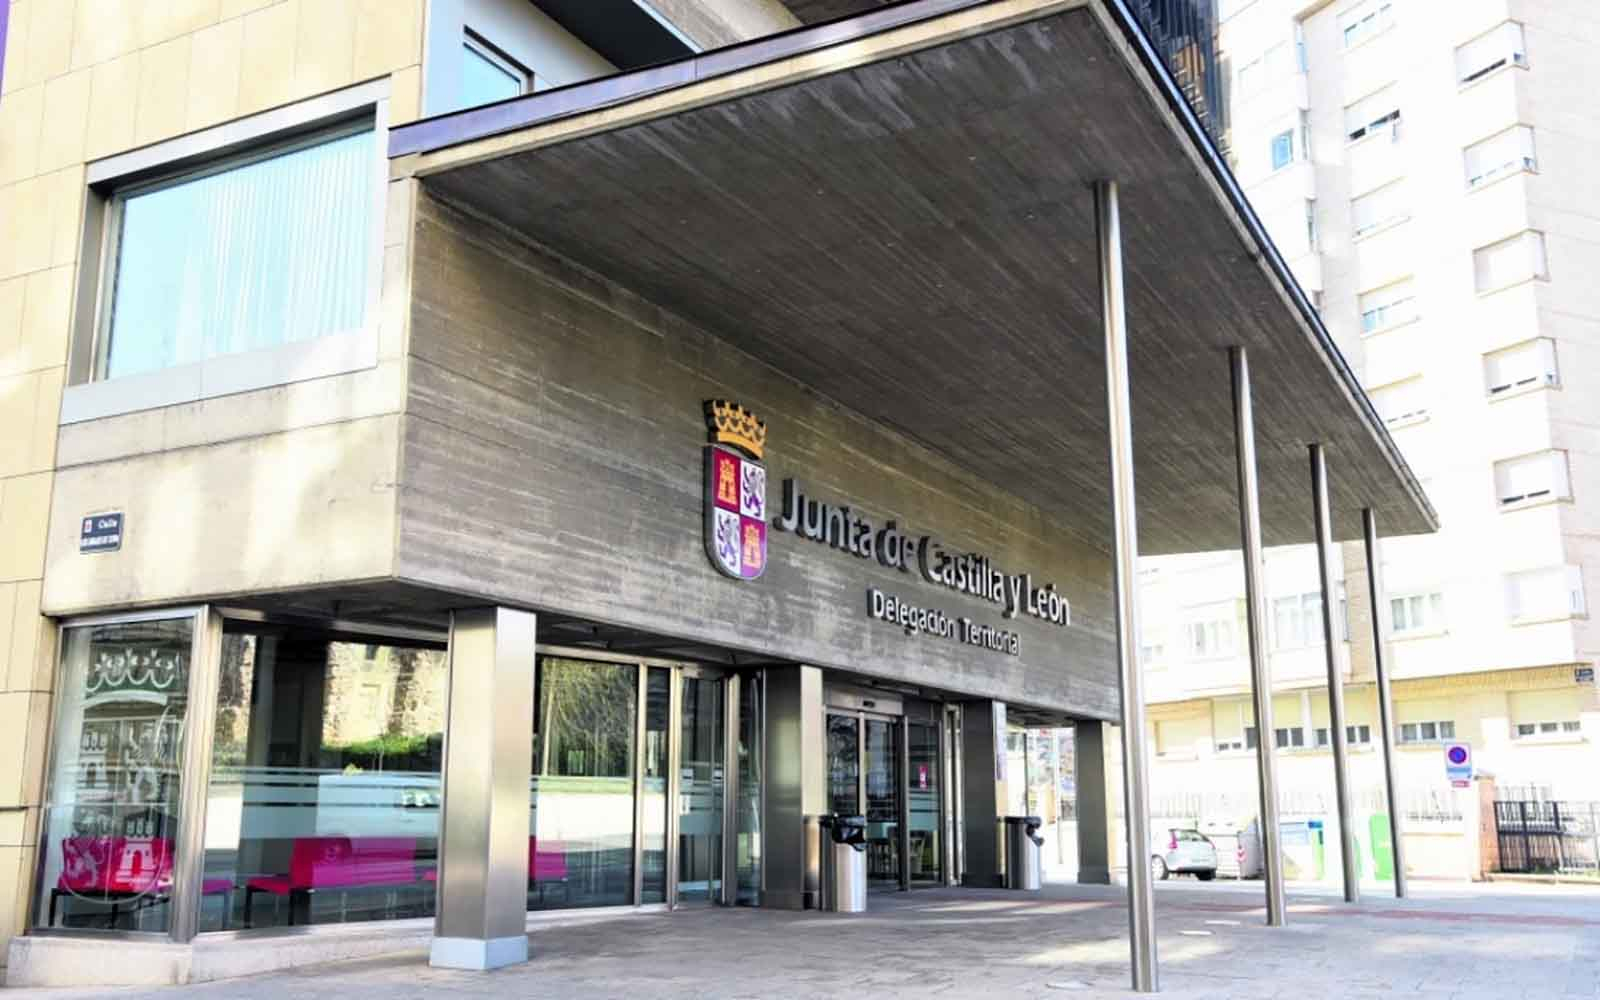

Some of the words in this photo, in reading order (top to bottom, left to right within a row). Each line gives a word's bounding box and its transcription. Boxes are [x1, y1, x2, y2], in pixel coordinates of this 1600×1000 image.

[774, 477, 876, 561] Junta
[877, 519, 917, 571] de
[917, 535, 1005, 607] Castilla
[1003, 575, 1021, 619] y
[1022, 571, 1072, 627] León
[867, 588, 956, 636] Delegación
[958, 617, 1020, 656] Territorial
